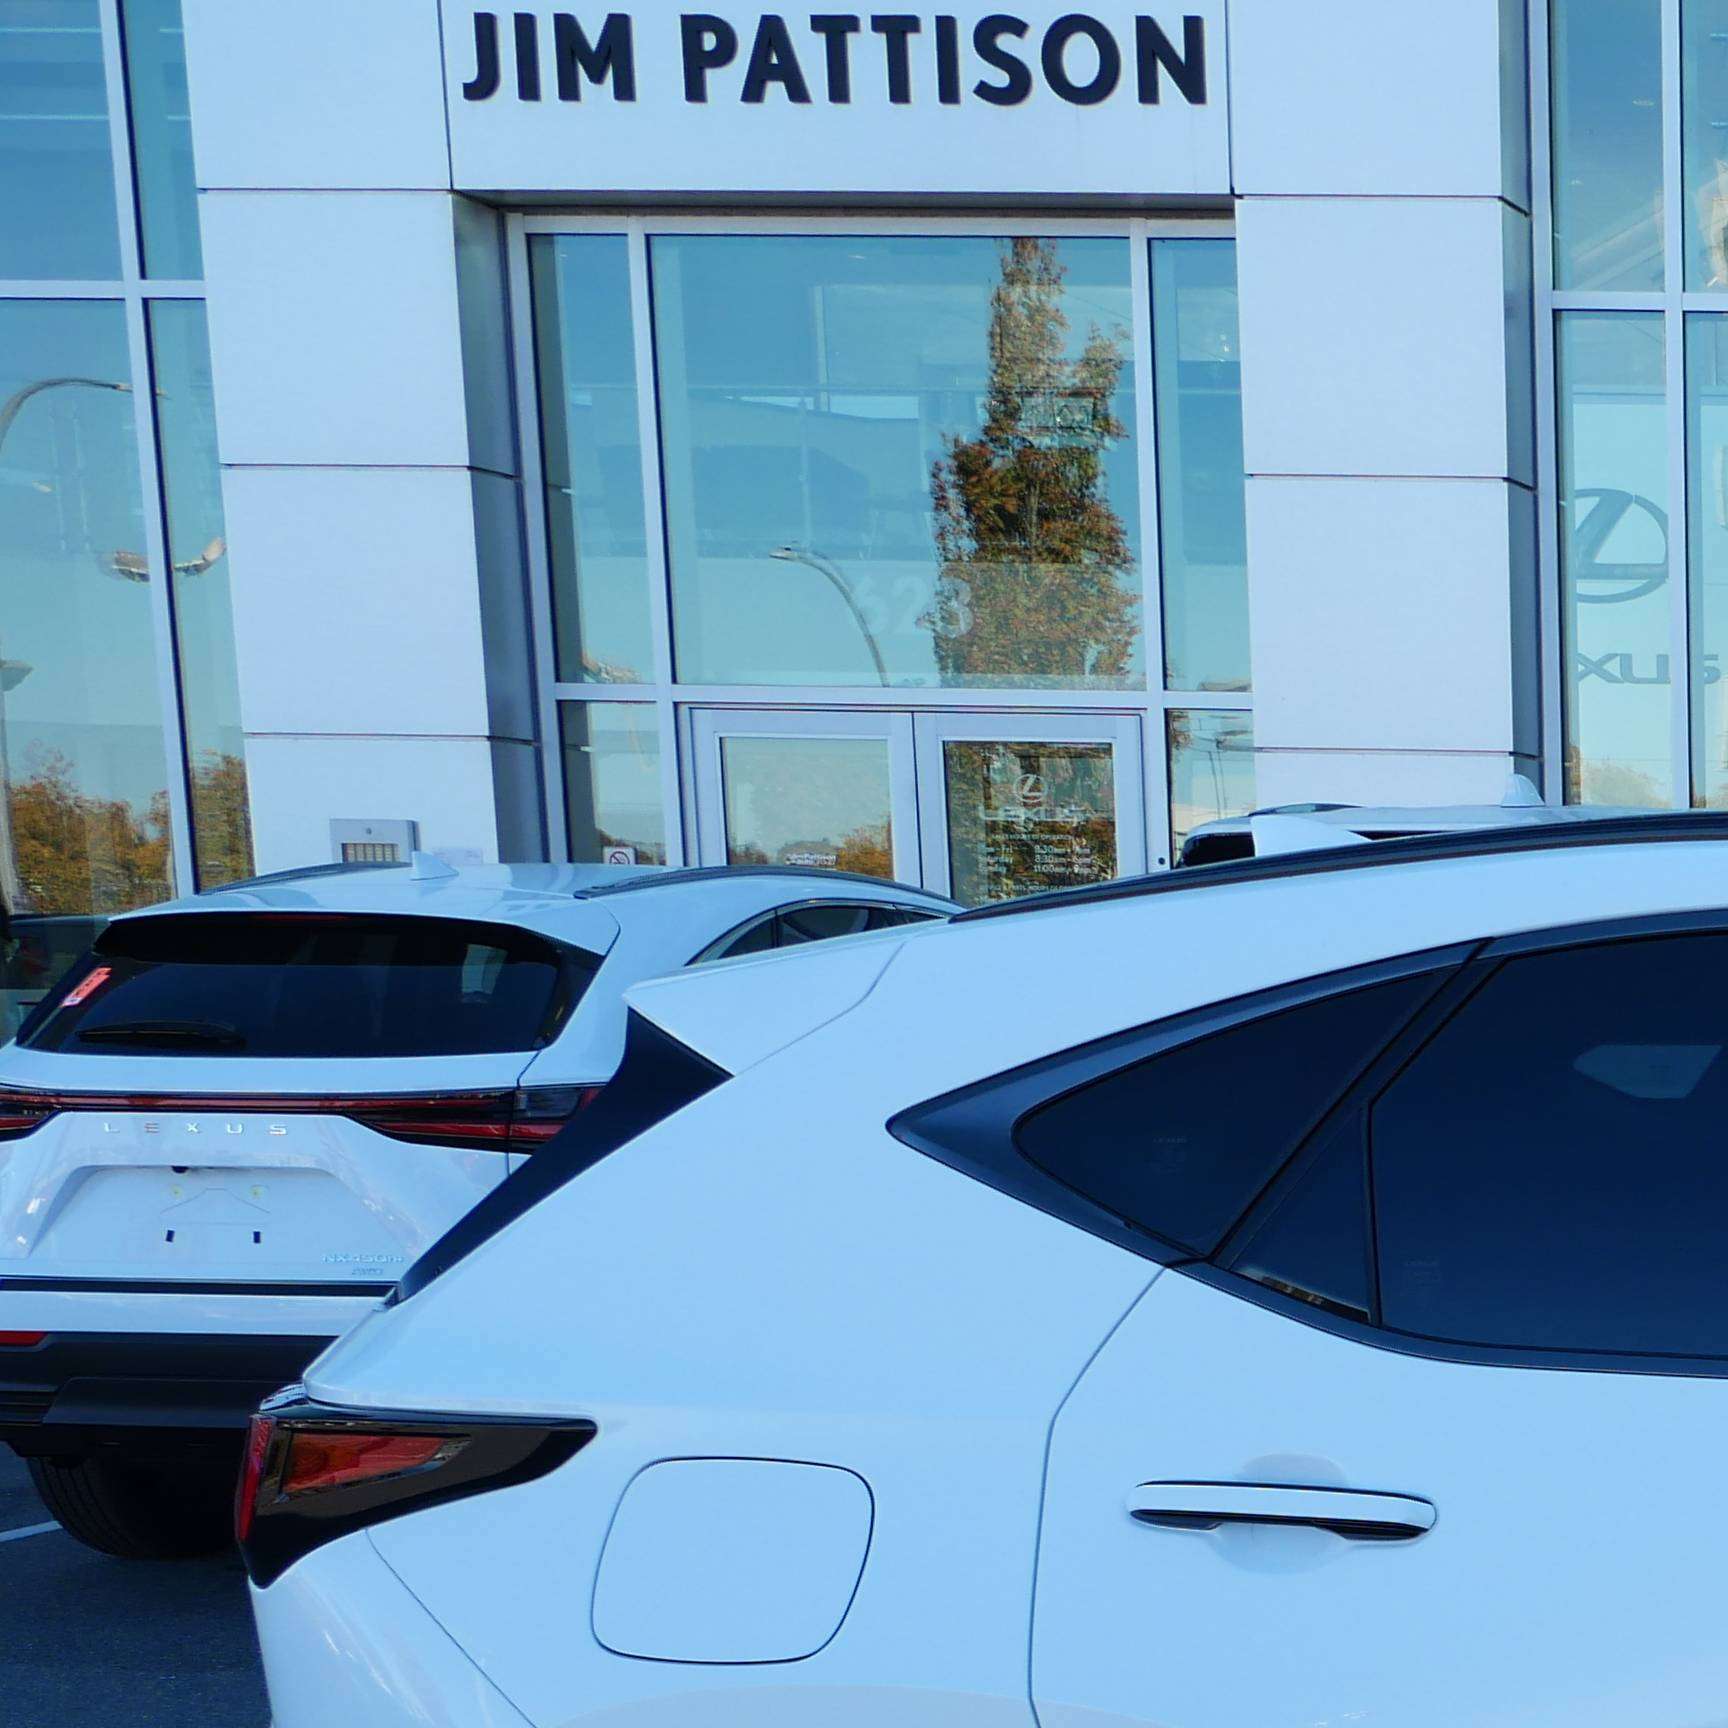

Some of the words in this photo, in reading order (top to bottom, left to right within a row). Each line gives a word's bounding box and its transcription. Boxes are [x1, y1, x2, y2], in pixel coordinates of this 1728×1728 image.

[462, 11, 637, 102] JIM
[680, 13, 1209, 105] PATTISON
[103, 1119, 288, 1137] LEXUS
